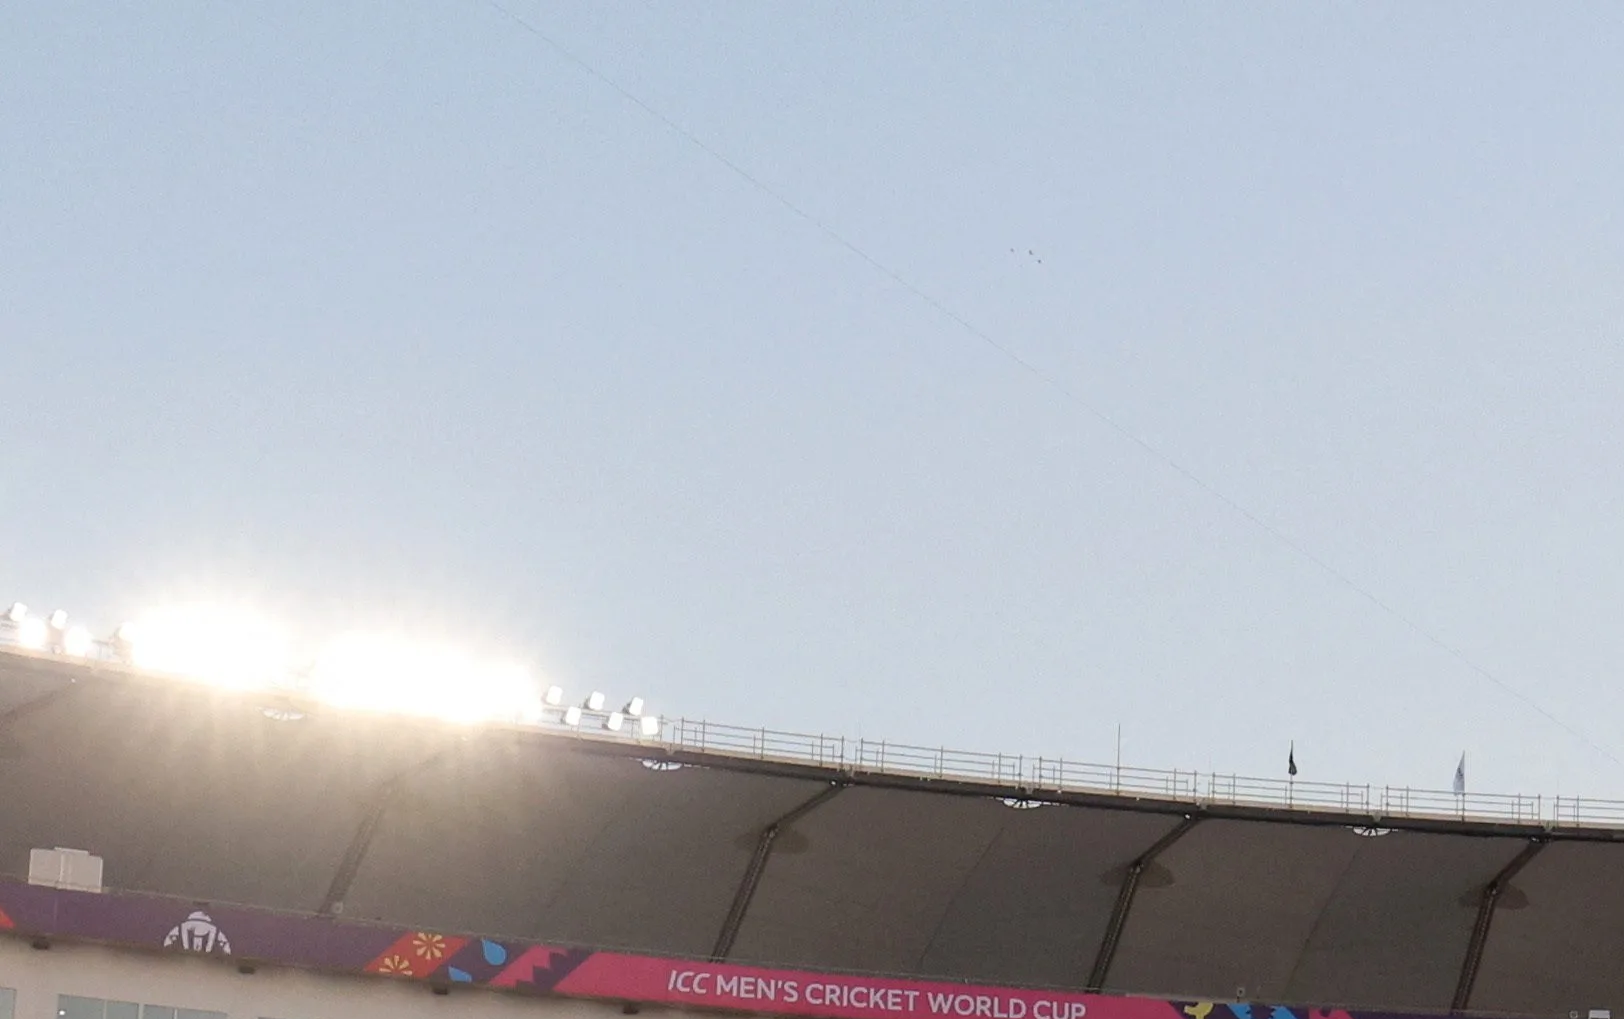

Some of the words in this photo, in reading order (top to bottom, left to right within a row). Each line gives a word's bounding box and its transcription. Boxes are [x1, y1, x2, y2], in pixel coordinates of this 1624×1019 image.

[667, 970, 711, 994] ICC
[715, 974, 799, 1003] MEN'S
[805, 983, 920, 1012] CRICKET
[927, 991, 1027, 1019] WORLD
